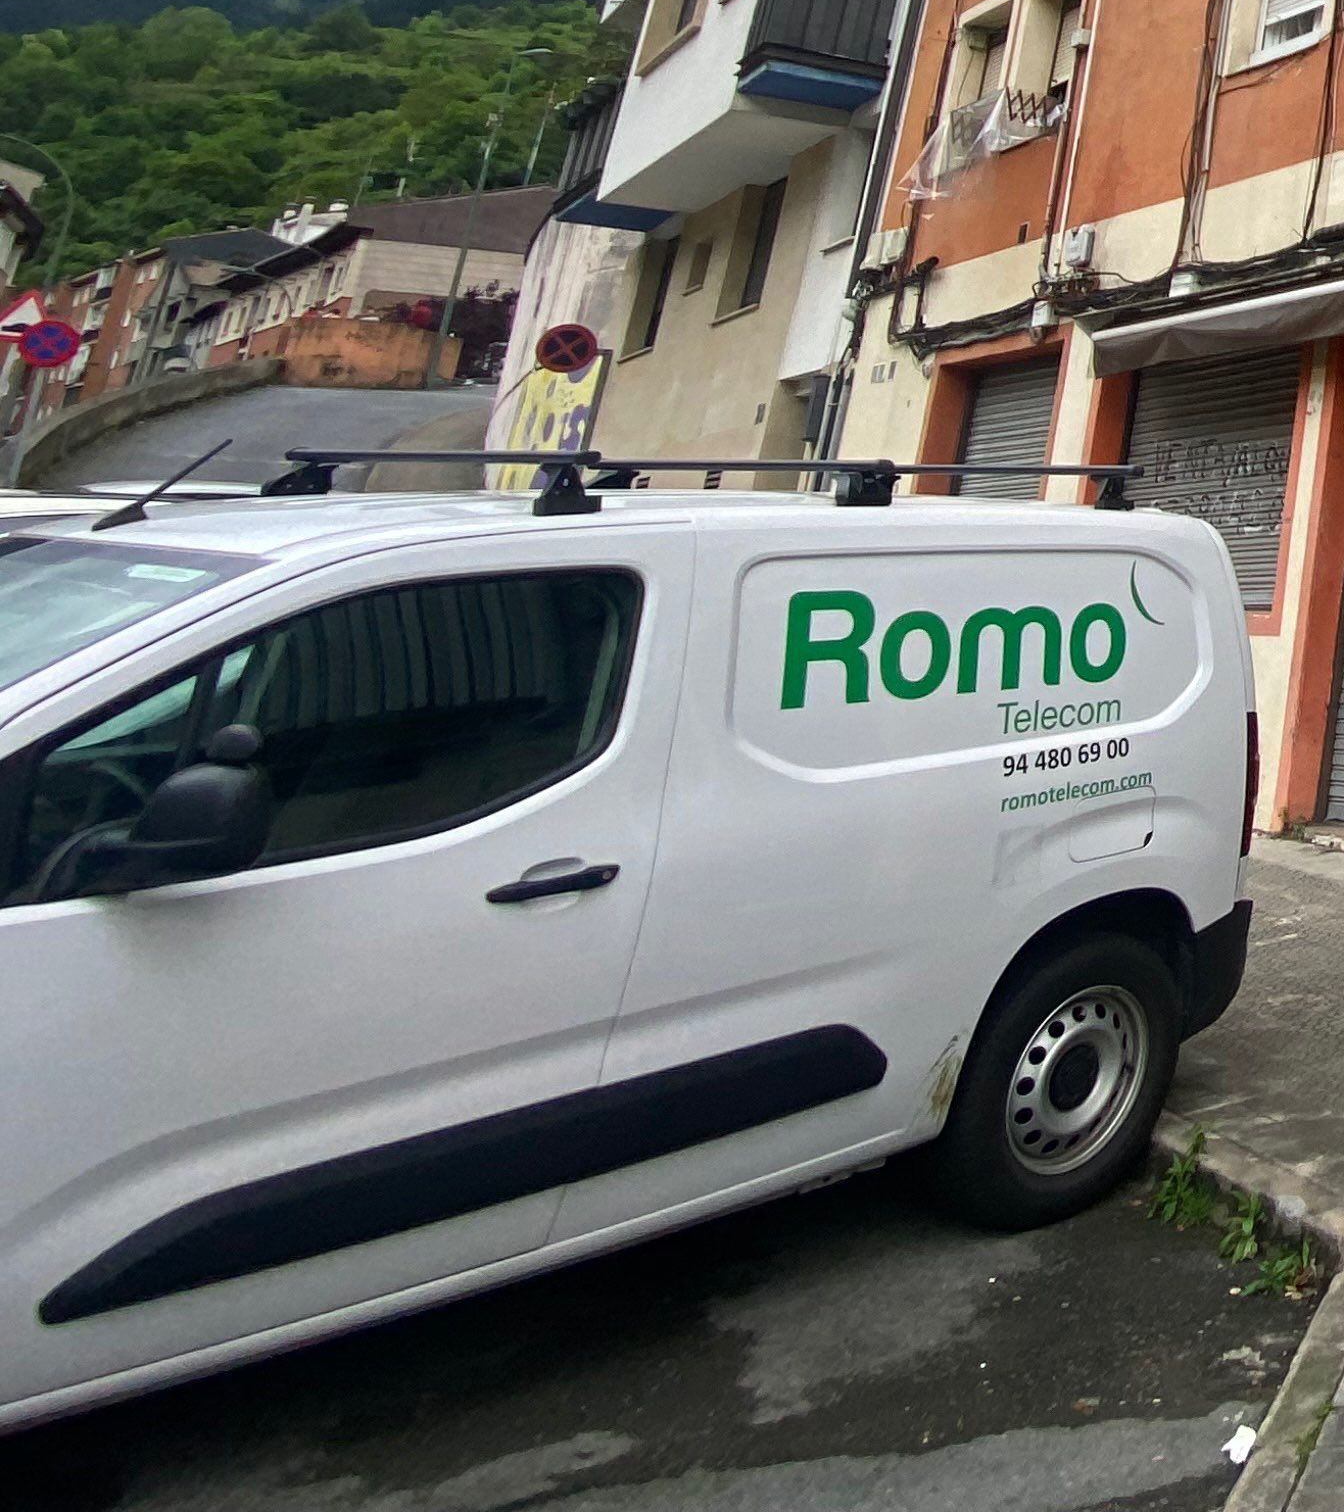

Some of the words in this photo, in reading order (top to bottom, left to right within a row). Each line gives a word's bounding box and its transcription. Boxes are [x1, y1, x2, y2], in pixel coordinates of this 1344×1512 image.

[780, 589, 1127, 710] Romo
[997, 699, 1121, 735] Telecom
[1002, 753, 1028, 778] 94
[1034, 746, 1072, 771] 480
[1077, 741, 1101, 765] 69
[1106, 737, 1130, 759] 00
[1000, 771, 1153, 813] romotelecom.com
